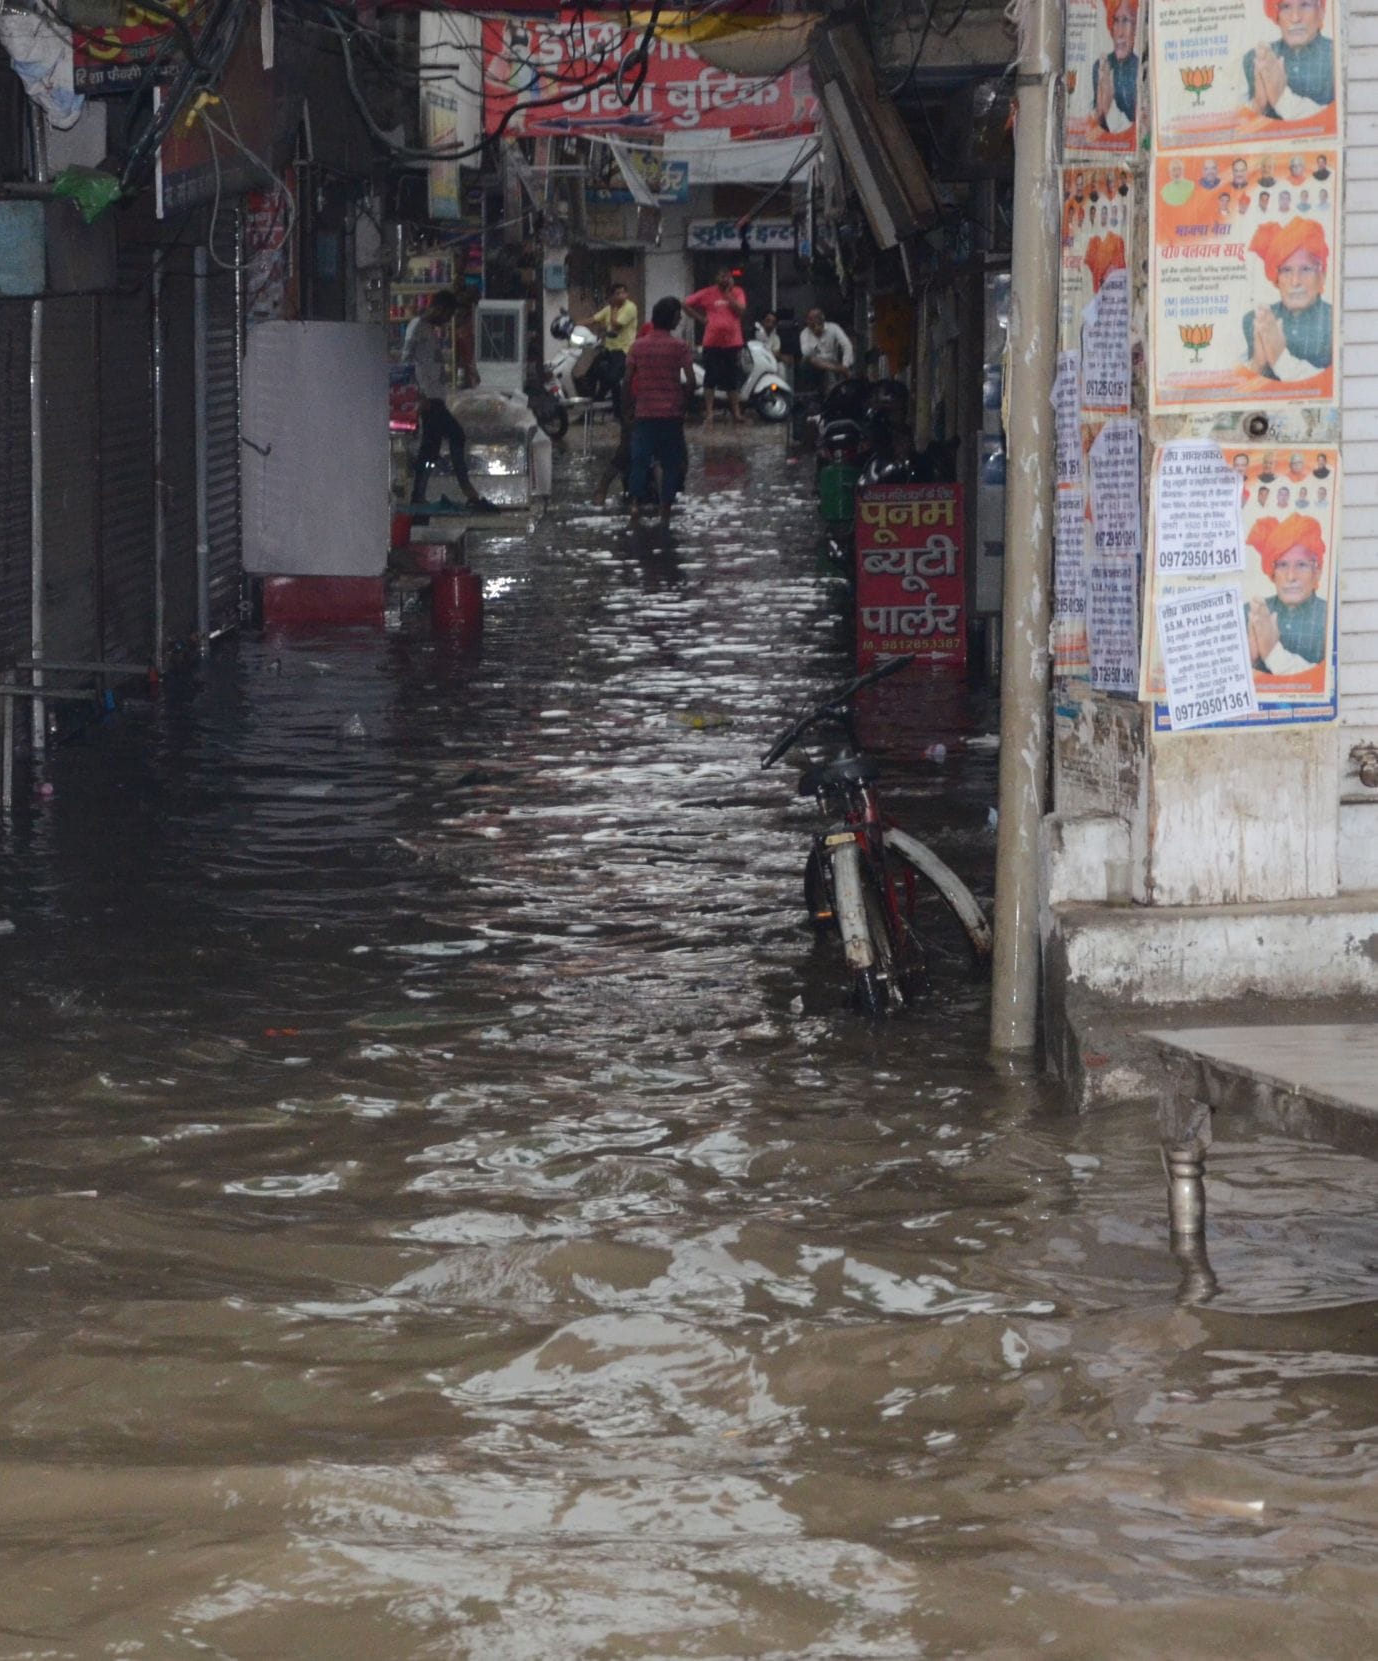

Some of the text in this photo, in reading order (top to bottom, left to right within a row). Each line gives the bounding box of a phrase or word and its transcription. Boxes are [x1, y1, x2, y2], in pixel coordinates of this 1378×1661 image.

[666, 66, 784, 127] बुटिक
[860, 500, 956, 543] पूनम
[862, 534, 959, 591] ब्यूटी
[1159, 548, 1237, 568] 09729501361
[861, 593, 960, 636] पार्लर
[1175, 691, 1250, 721] 09729501361
